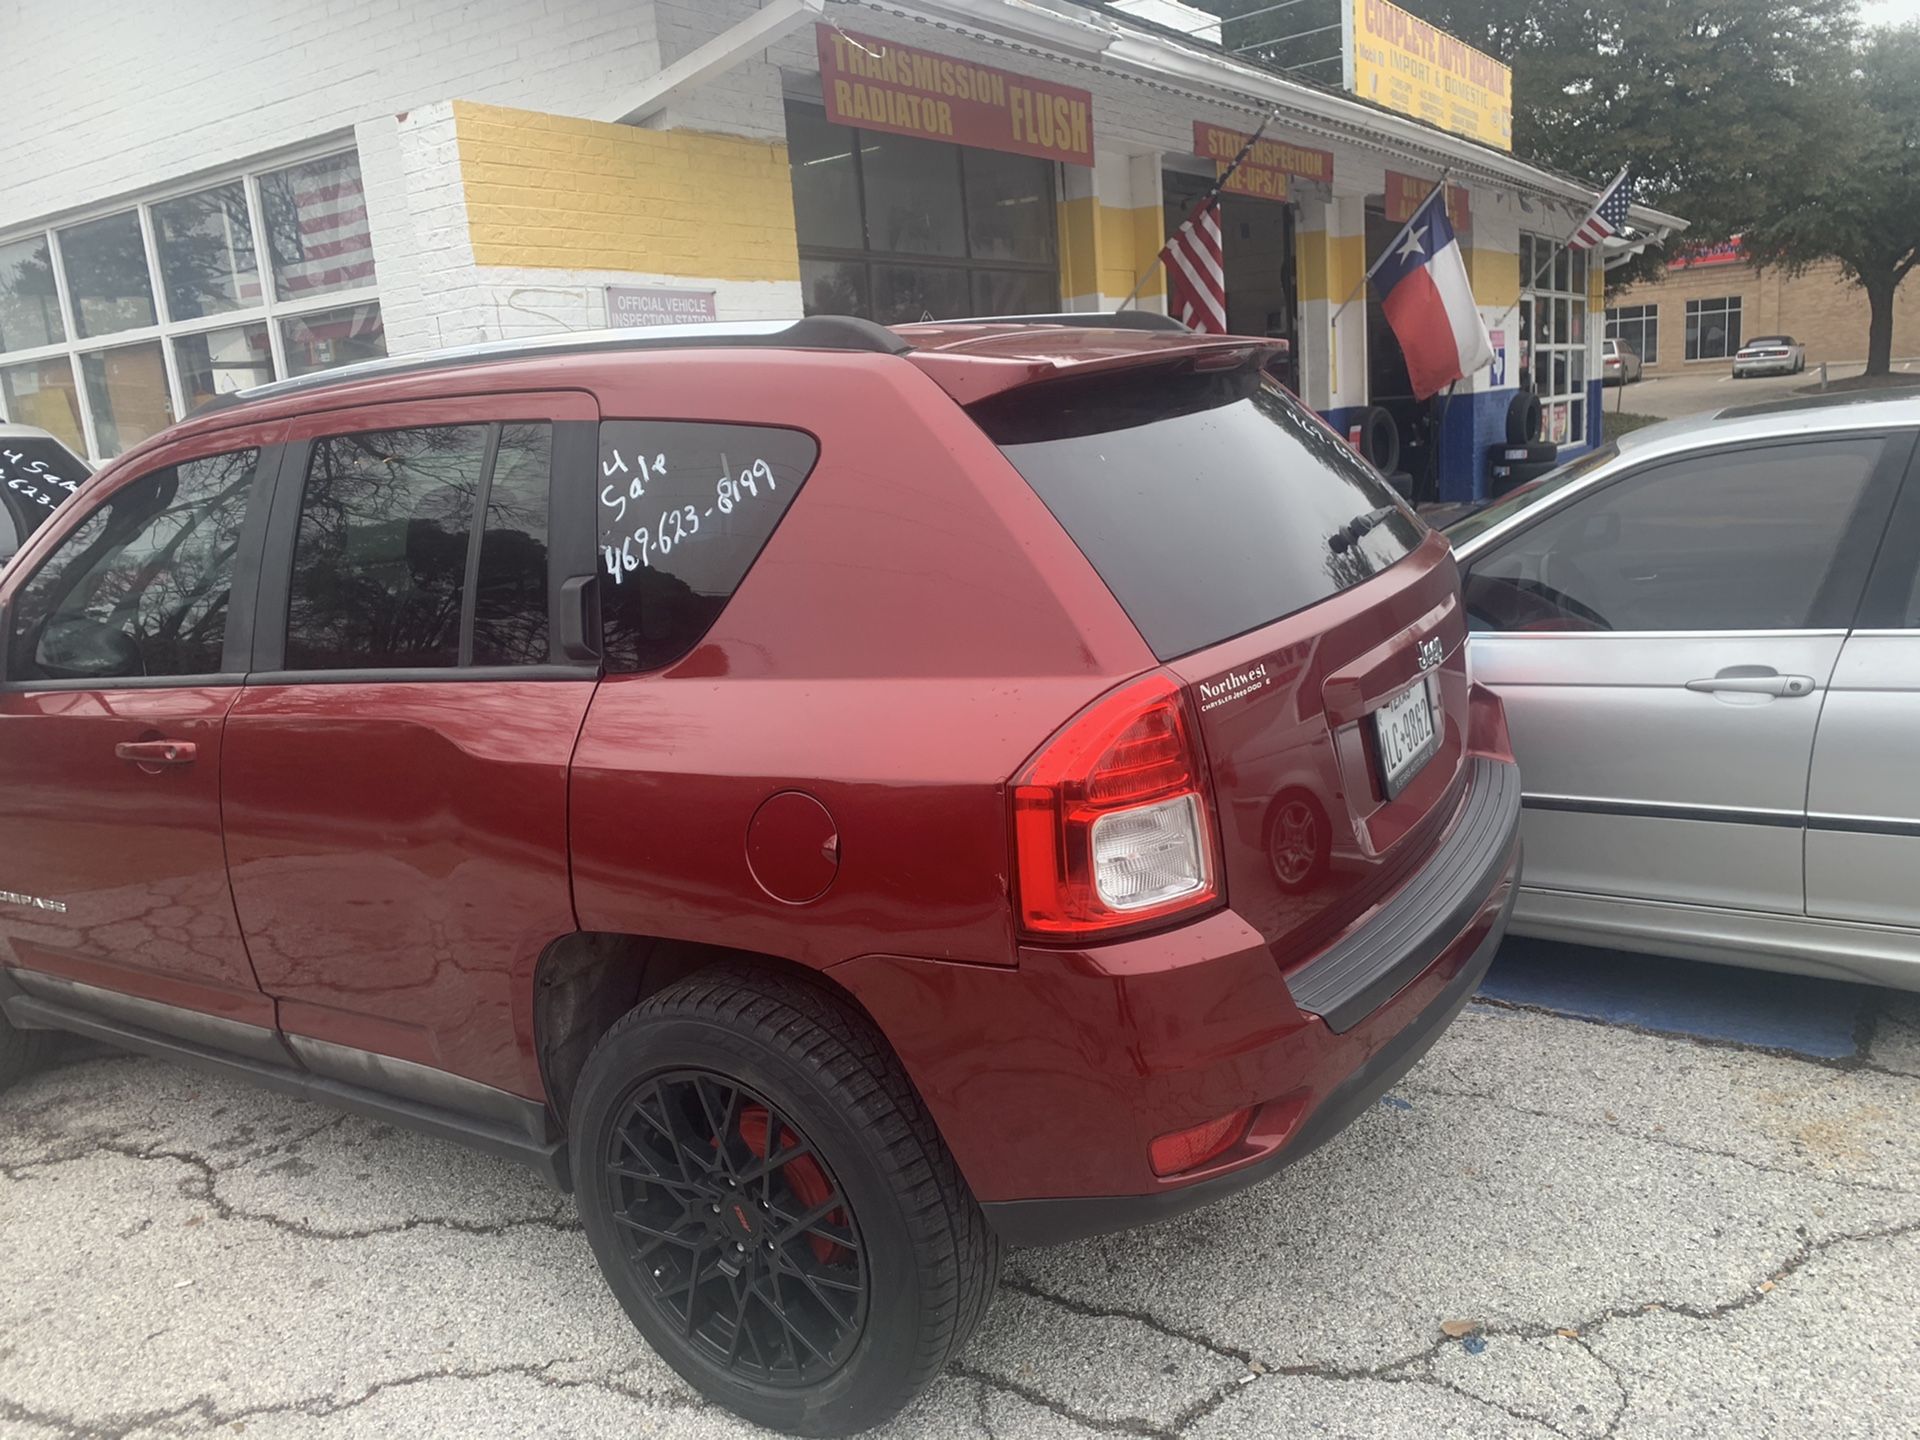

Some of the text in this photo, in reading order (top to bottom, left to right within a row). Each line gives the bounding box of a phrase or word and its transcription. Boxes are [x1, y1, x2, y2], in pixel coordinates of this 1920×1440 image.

[1364, 0, 1435, 65] COMPLETE
[1470, 52, 1505, 98] REPAIR
[830, 33, 1006, 107] TRANSMISSION
[1390, 48, 1430, 84] IMPORT
[1444, 75, 1488, 110] DOMESTIC
[834, 79, 953, 136] RADIATOR
[1008, 85, 1089, 154] FLUSH
[1252, 140, 1323, 176] INSPECTION
[612, 312, 717, 328] INSPECTION STATION
[617, 295, 708, 314] OFFICIAL VEHICLE
[603, 449, 629, 476] 4
[601, 453, 667, 522] Sale
[1417, 636, 1443, 670] Jeep
[1199, 663, 1268, 701] Northwest
[1201, 695, 1233, 712] CHRYSLER
